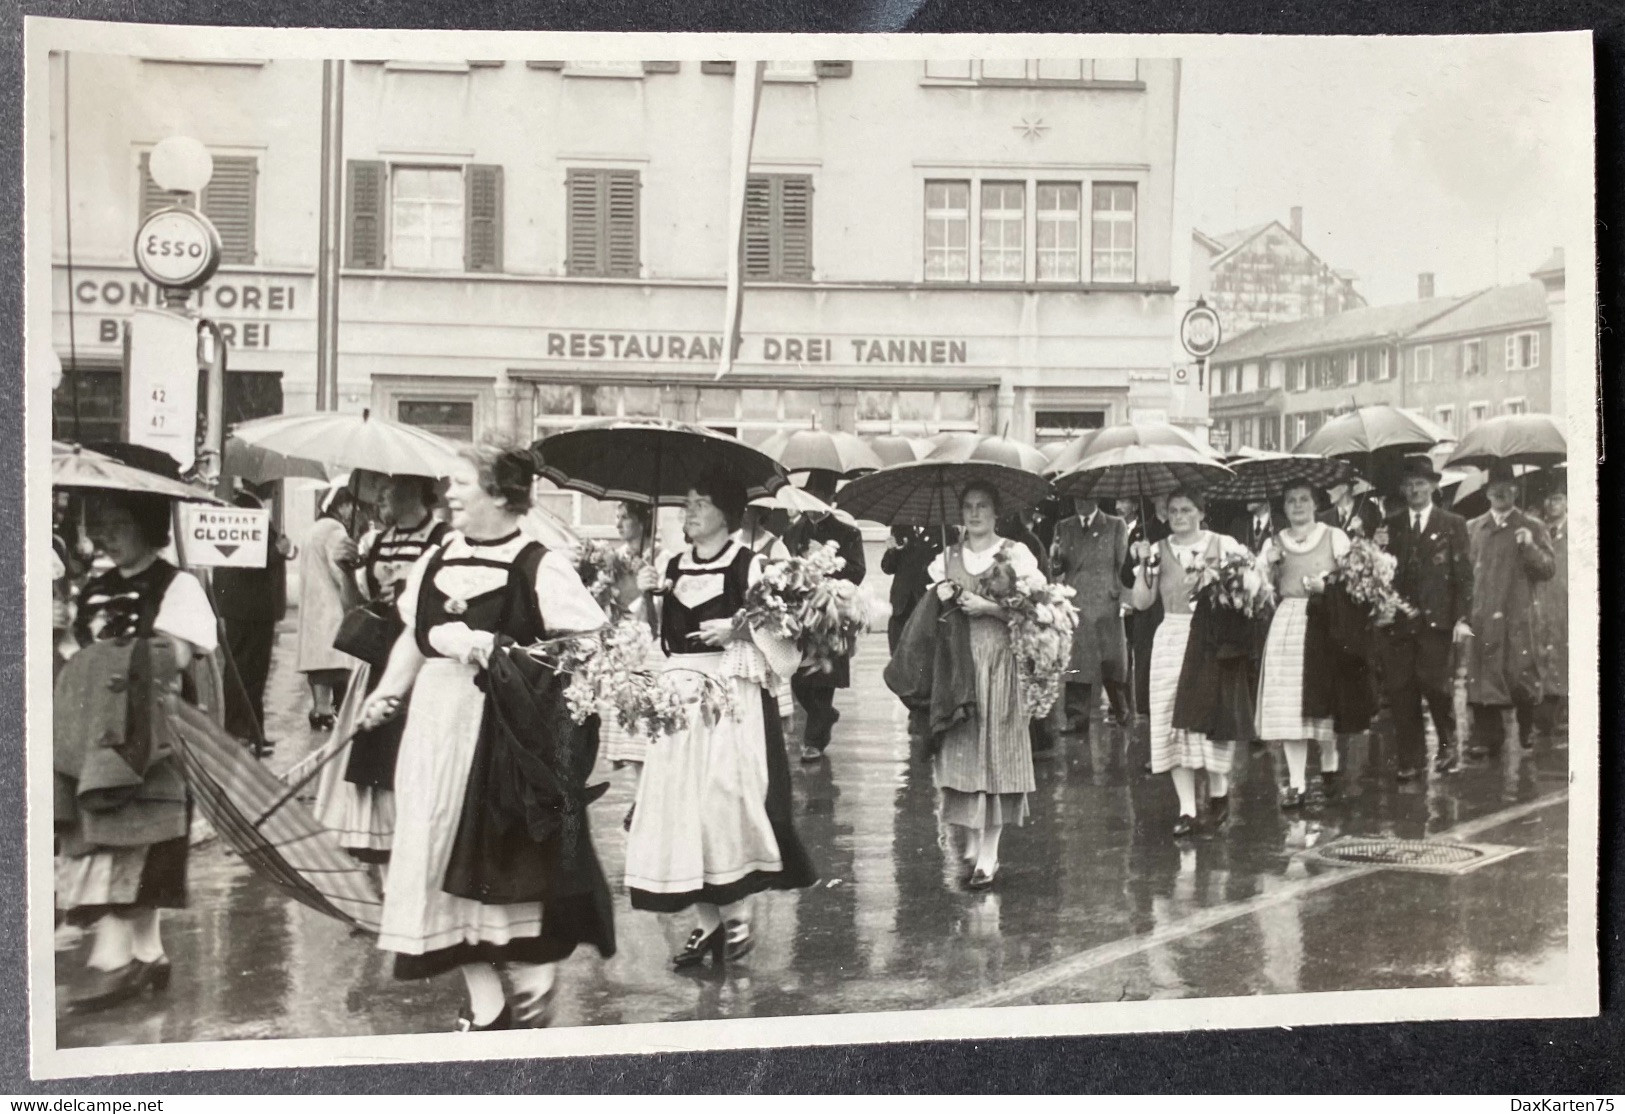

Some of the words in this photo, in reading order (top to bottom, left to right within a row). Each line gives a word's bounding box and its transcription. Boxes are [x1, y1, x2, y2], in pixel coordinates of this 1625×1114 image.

[76, 280, 295, 310] CONTOREI
[99, 318, 270, 347] BREI
[763, 337, 832, 362] DREI
[851, 338, 967, 364] TANNEN
[151, 390, 166, 403] 42
[194, 528, 262, 541] GLOCKE
